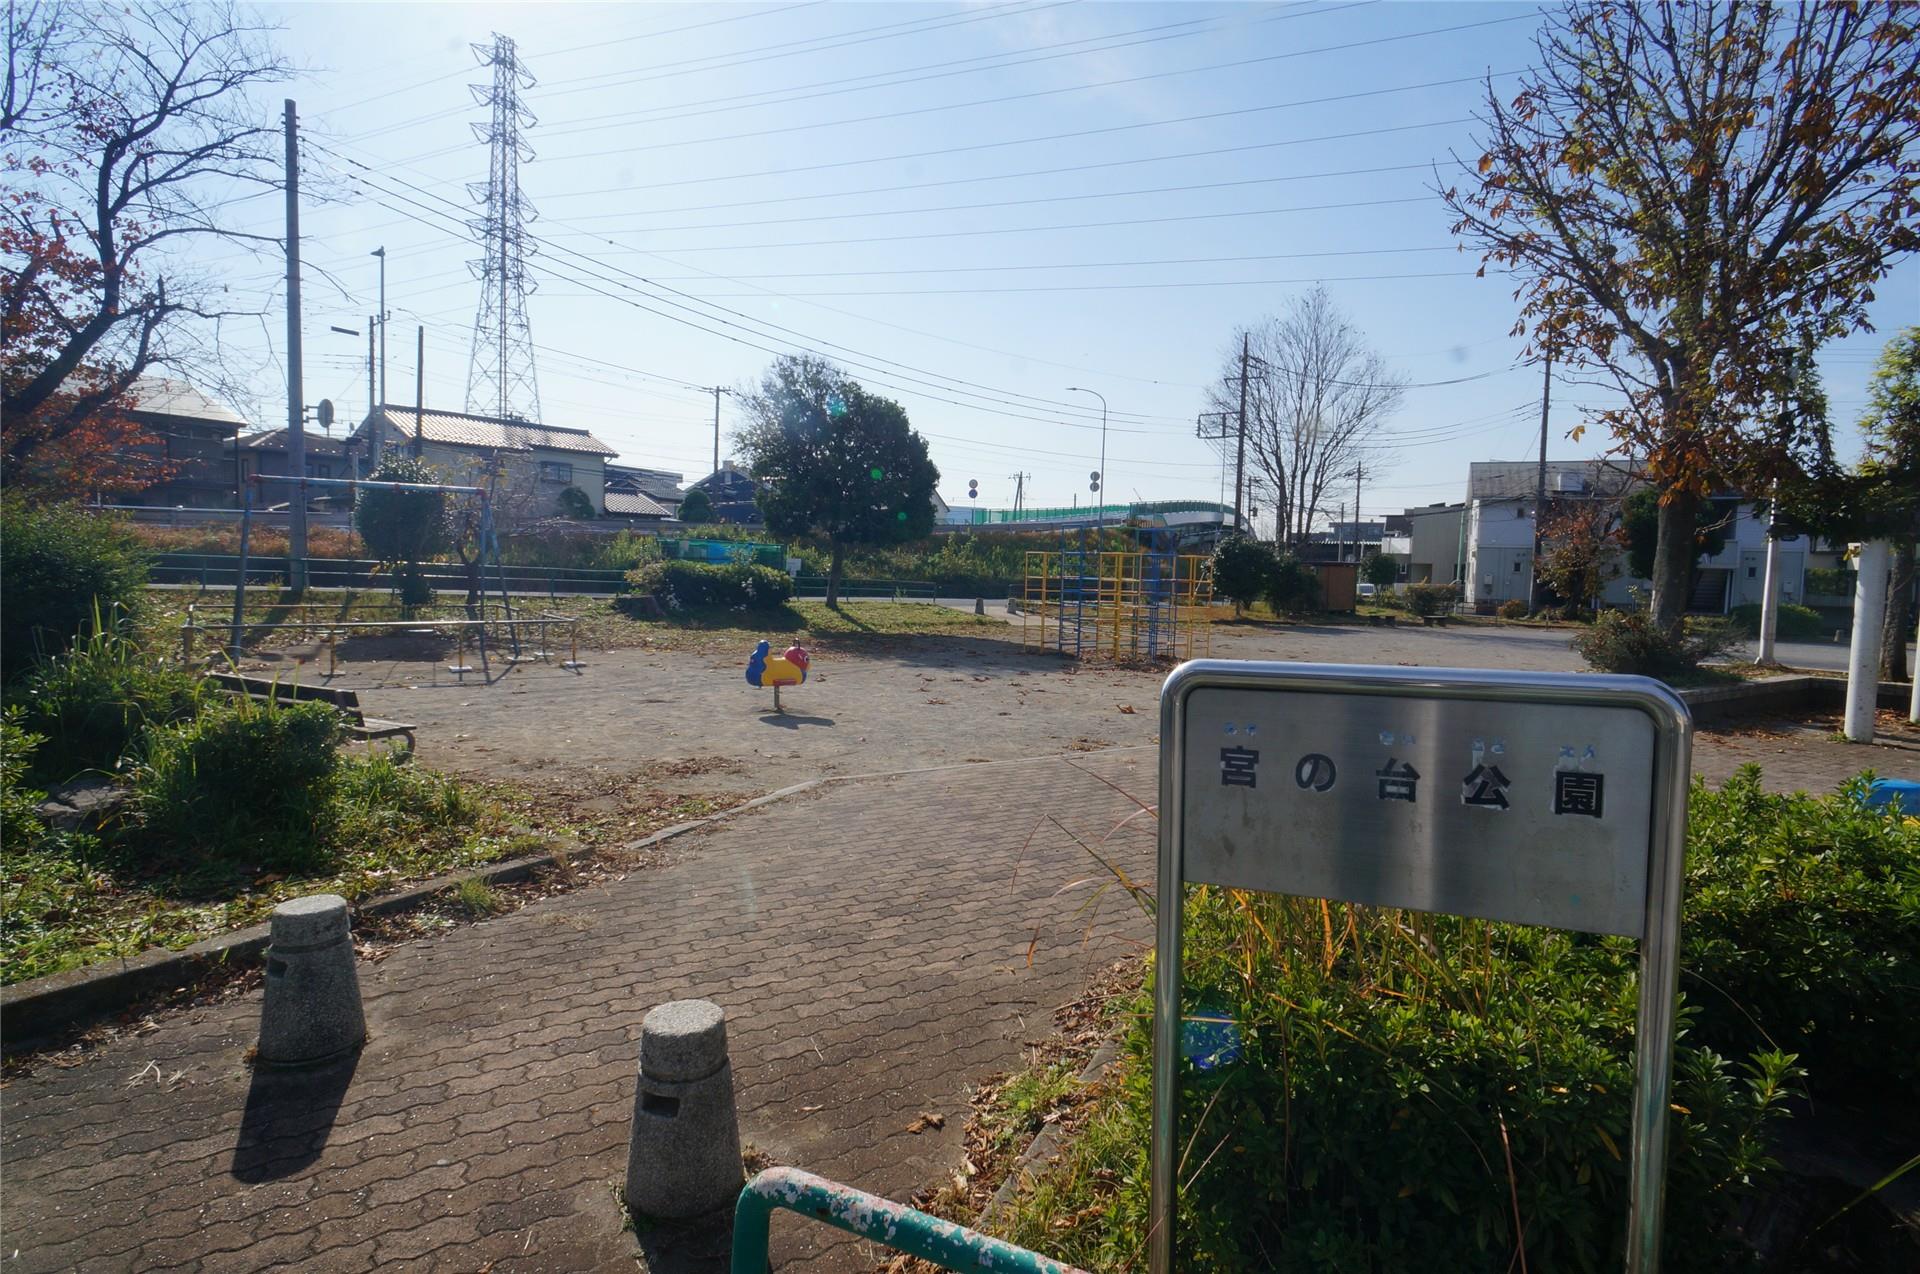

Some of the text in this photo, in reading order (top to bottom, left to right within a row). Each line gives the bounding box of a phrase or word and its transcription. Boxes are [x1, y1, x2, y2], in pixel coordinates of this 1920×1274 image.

[1219, 745, 1605, 819] 宮の台公園
